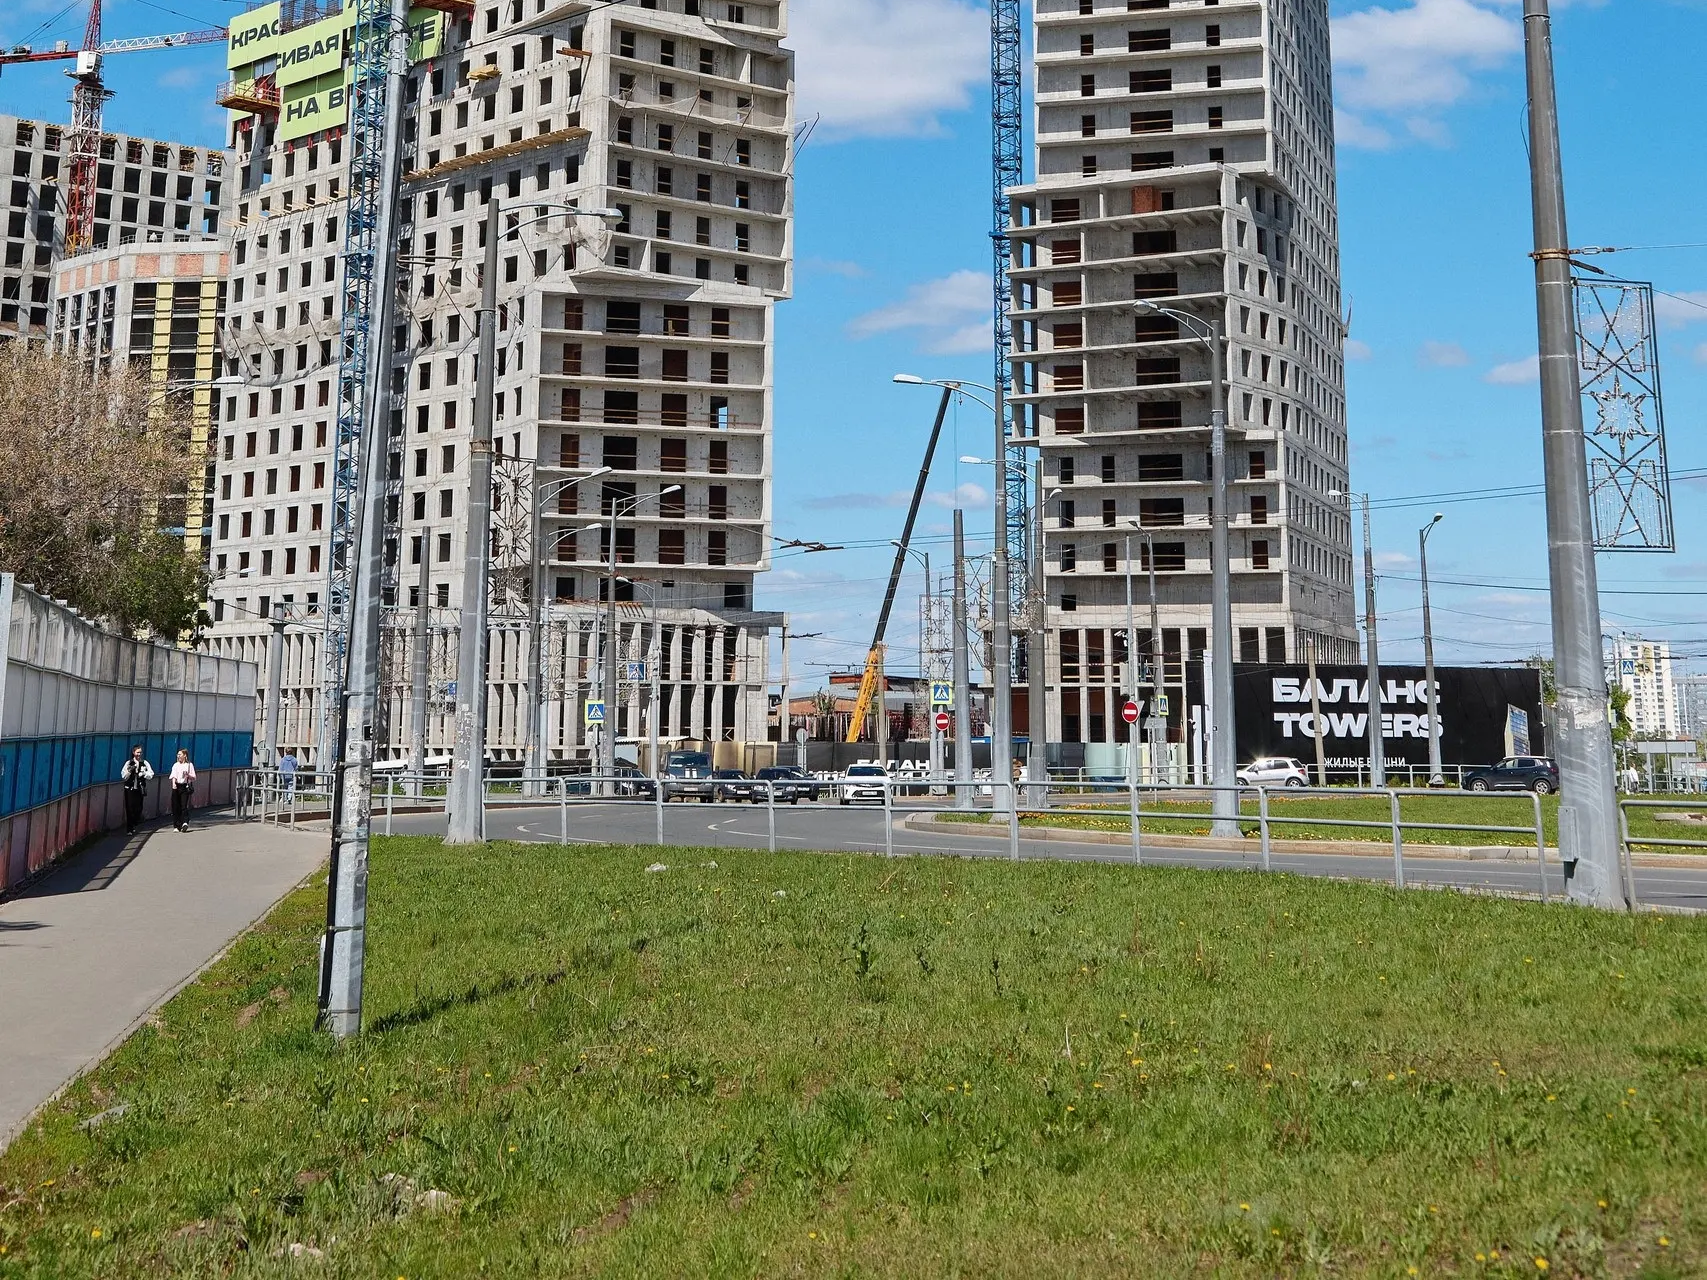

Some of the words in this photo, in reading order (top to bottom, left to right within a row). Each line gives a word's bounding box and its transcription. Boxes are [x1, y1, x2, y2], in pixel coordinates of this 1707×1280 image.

[286, 96, 321, 122] НА
[1272, 677, 1441, 704] БАЛАНС
[1273, 712, 1444, 738] TOWERS
